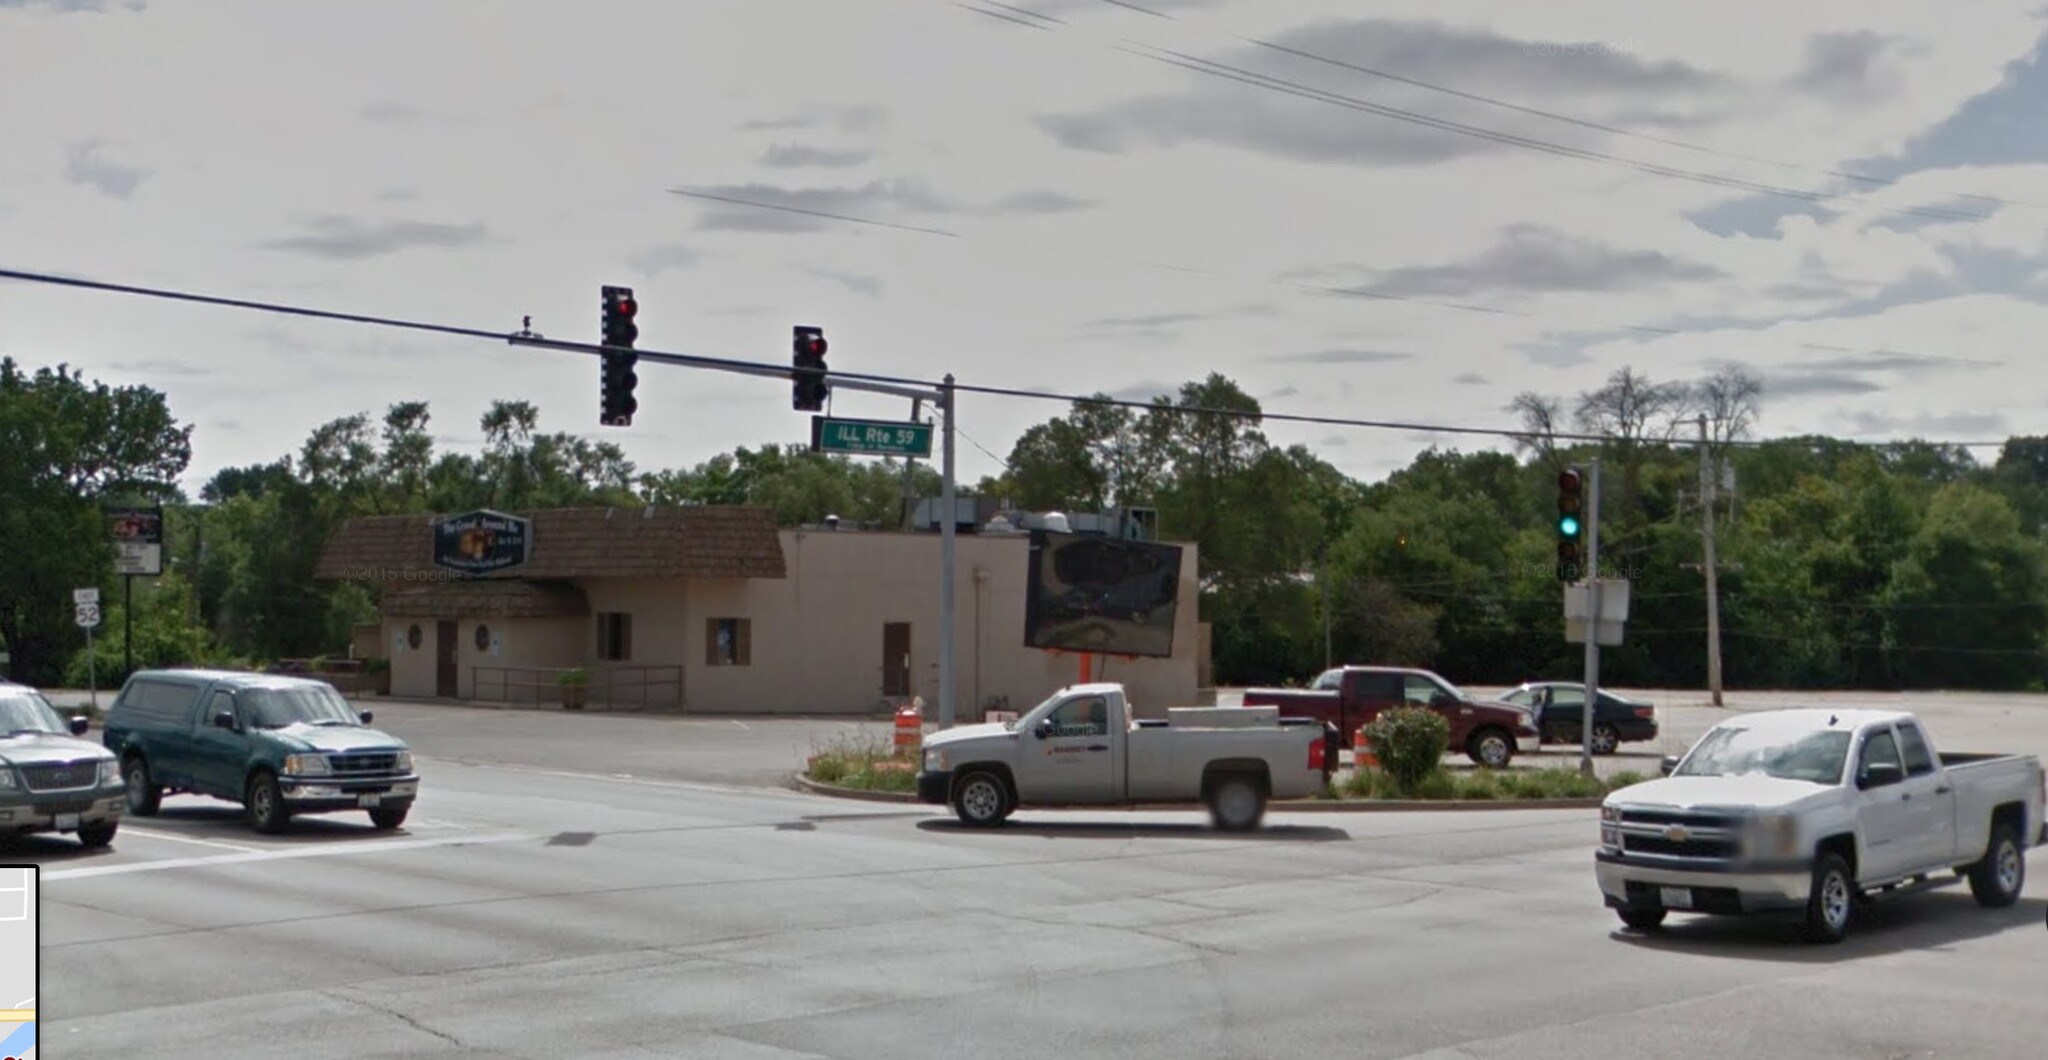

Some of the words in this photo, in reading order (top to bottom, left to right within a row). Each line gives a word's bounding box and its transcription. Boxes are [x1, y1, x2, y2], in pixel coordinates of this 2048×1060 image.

[838, 426, 860, 441] ILL
[865, 428, 891, 443] Rte
[896, 430, 915, 445] 59
[79, 606, 98, 623] 52
